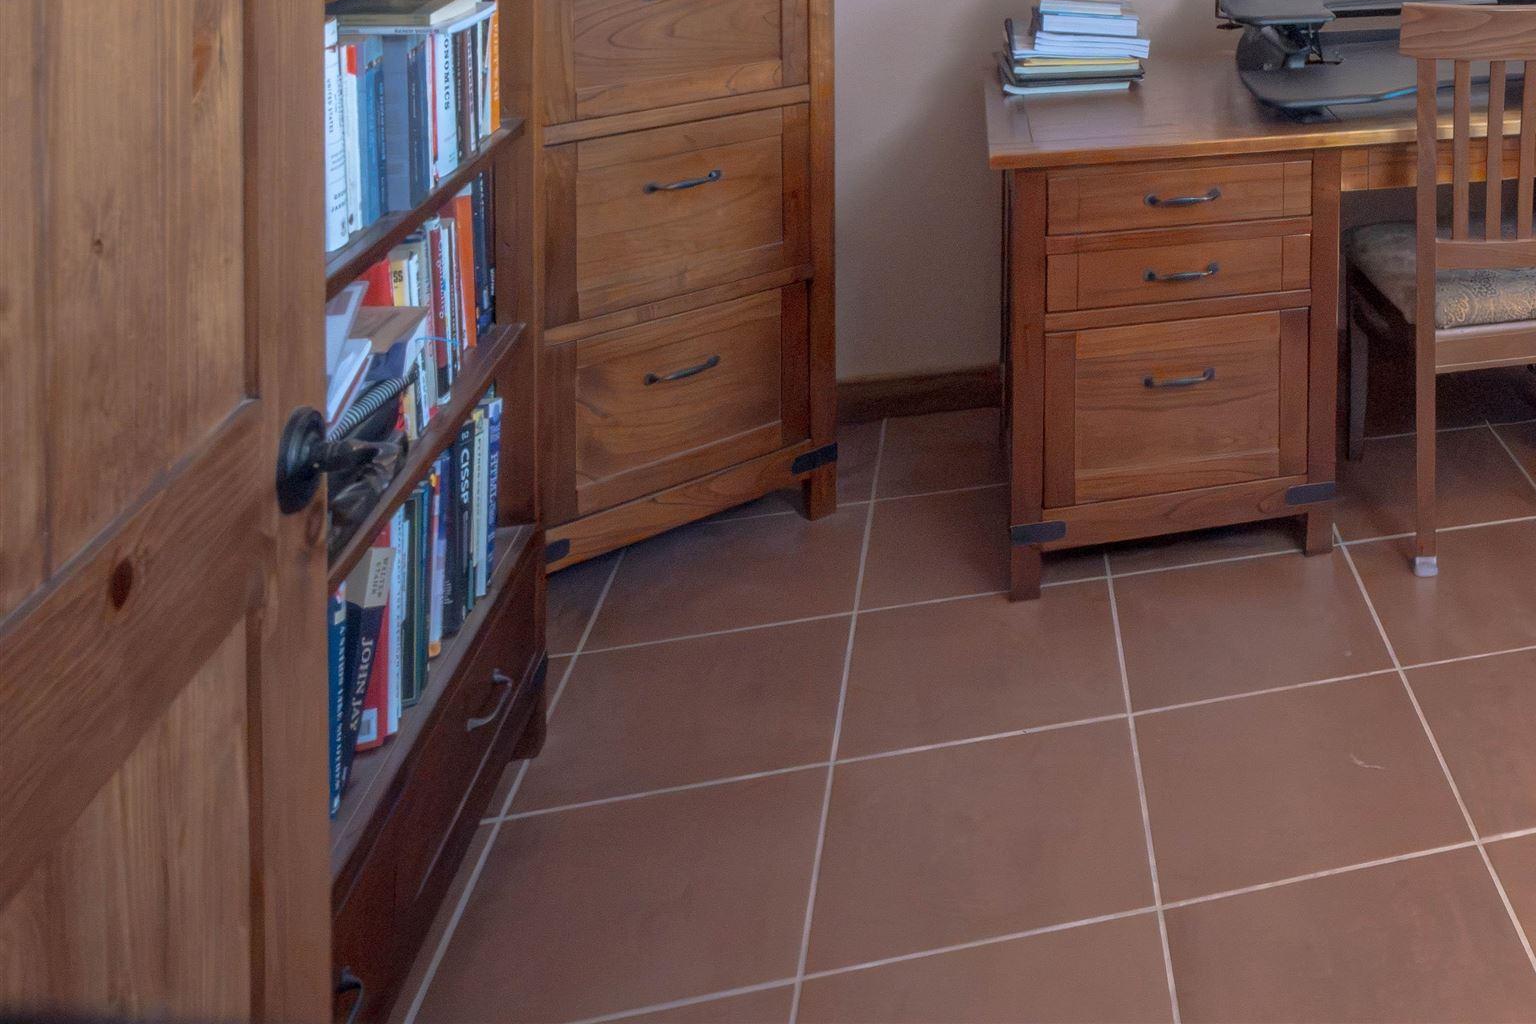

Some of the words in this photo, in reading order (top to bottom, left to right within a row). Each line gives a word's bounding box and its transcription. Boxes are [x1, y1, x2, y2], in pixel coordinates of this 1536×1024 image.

[443, 34, 451, 111] ONOMICS
[460, 447, 470, 504] CISSP
[355, 636, 373, 694] JOHN
[349, 697, 363, 731] JAY
